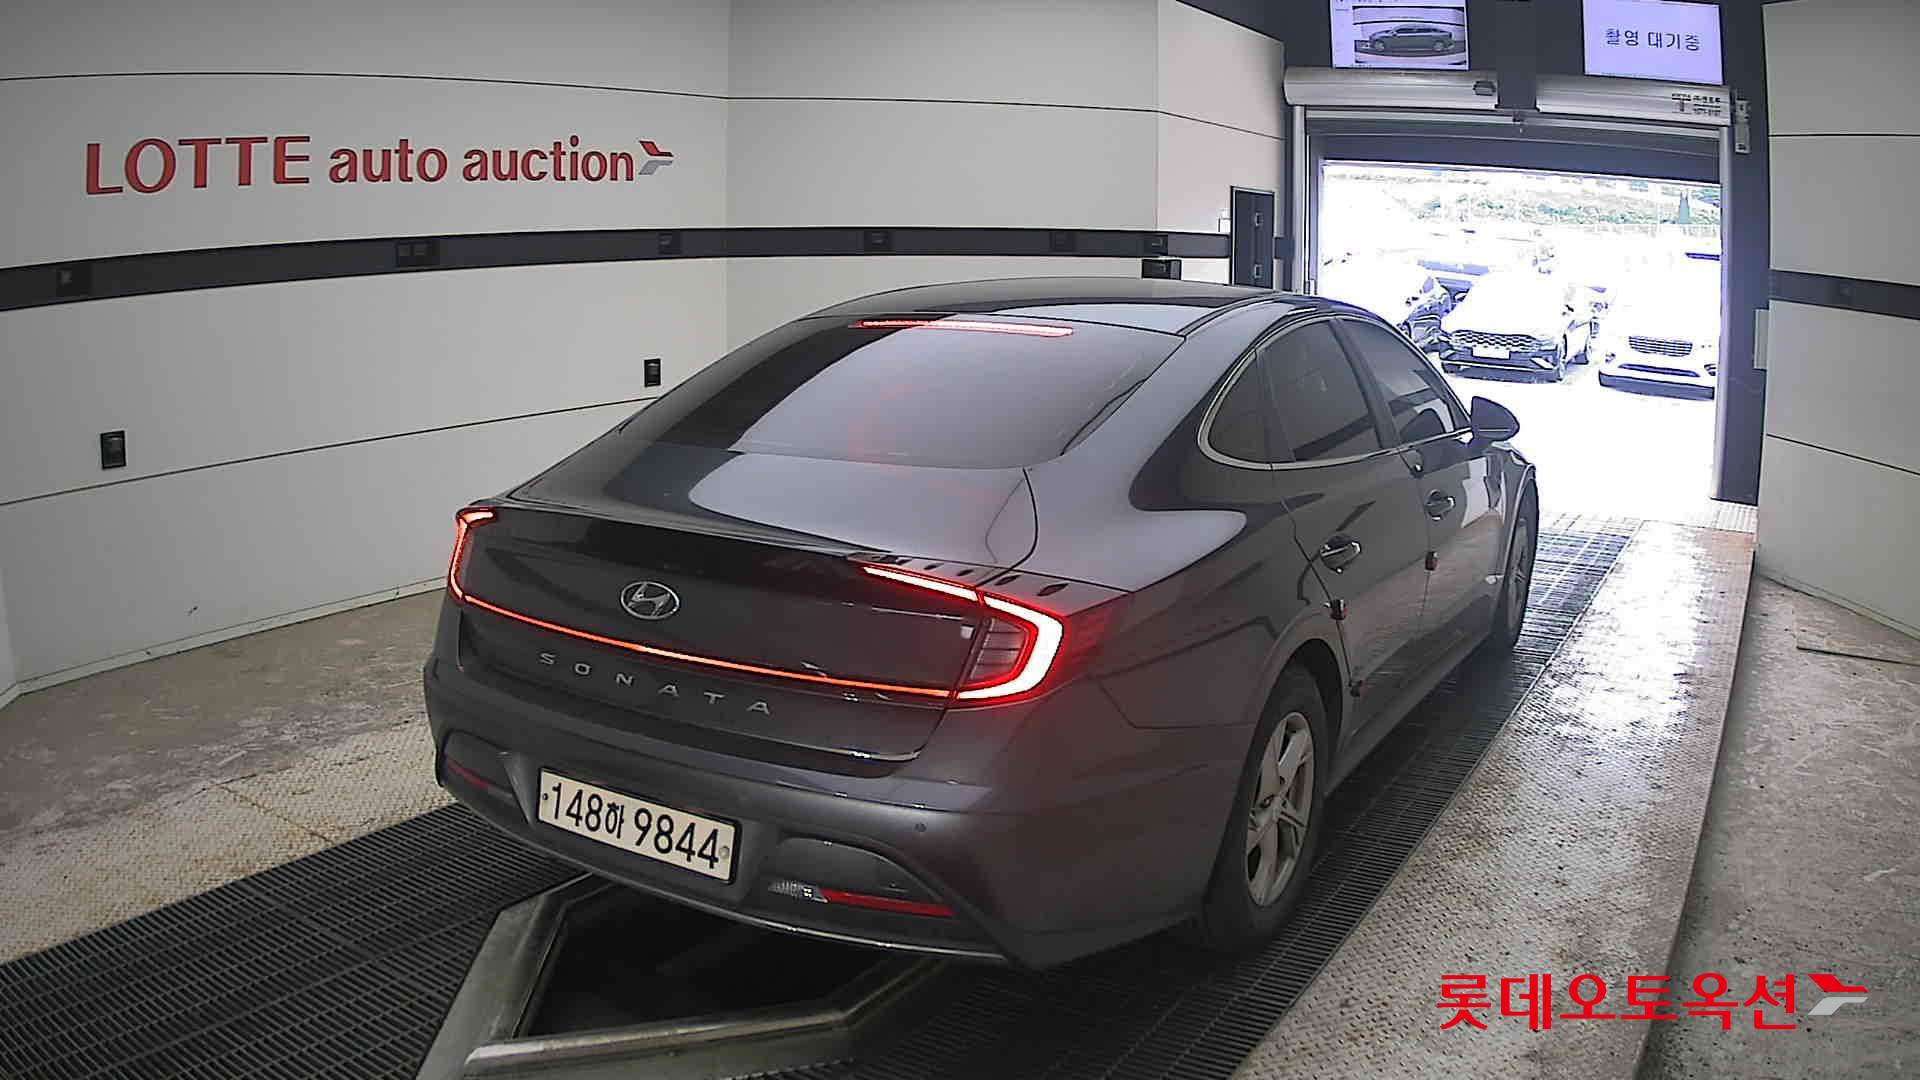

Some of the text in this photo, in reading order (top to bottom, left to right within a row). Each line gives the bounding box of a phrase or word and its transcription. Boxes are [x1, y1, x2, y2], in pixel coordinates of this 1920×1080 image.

[1605, 28, 1700, 51] 촬영 대기중
[86, 135, 635, 195] LOTTE auto auction
[540, 652, 770, 715] SONATA
[552, 782, 719, 869] 148하 9844
